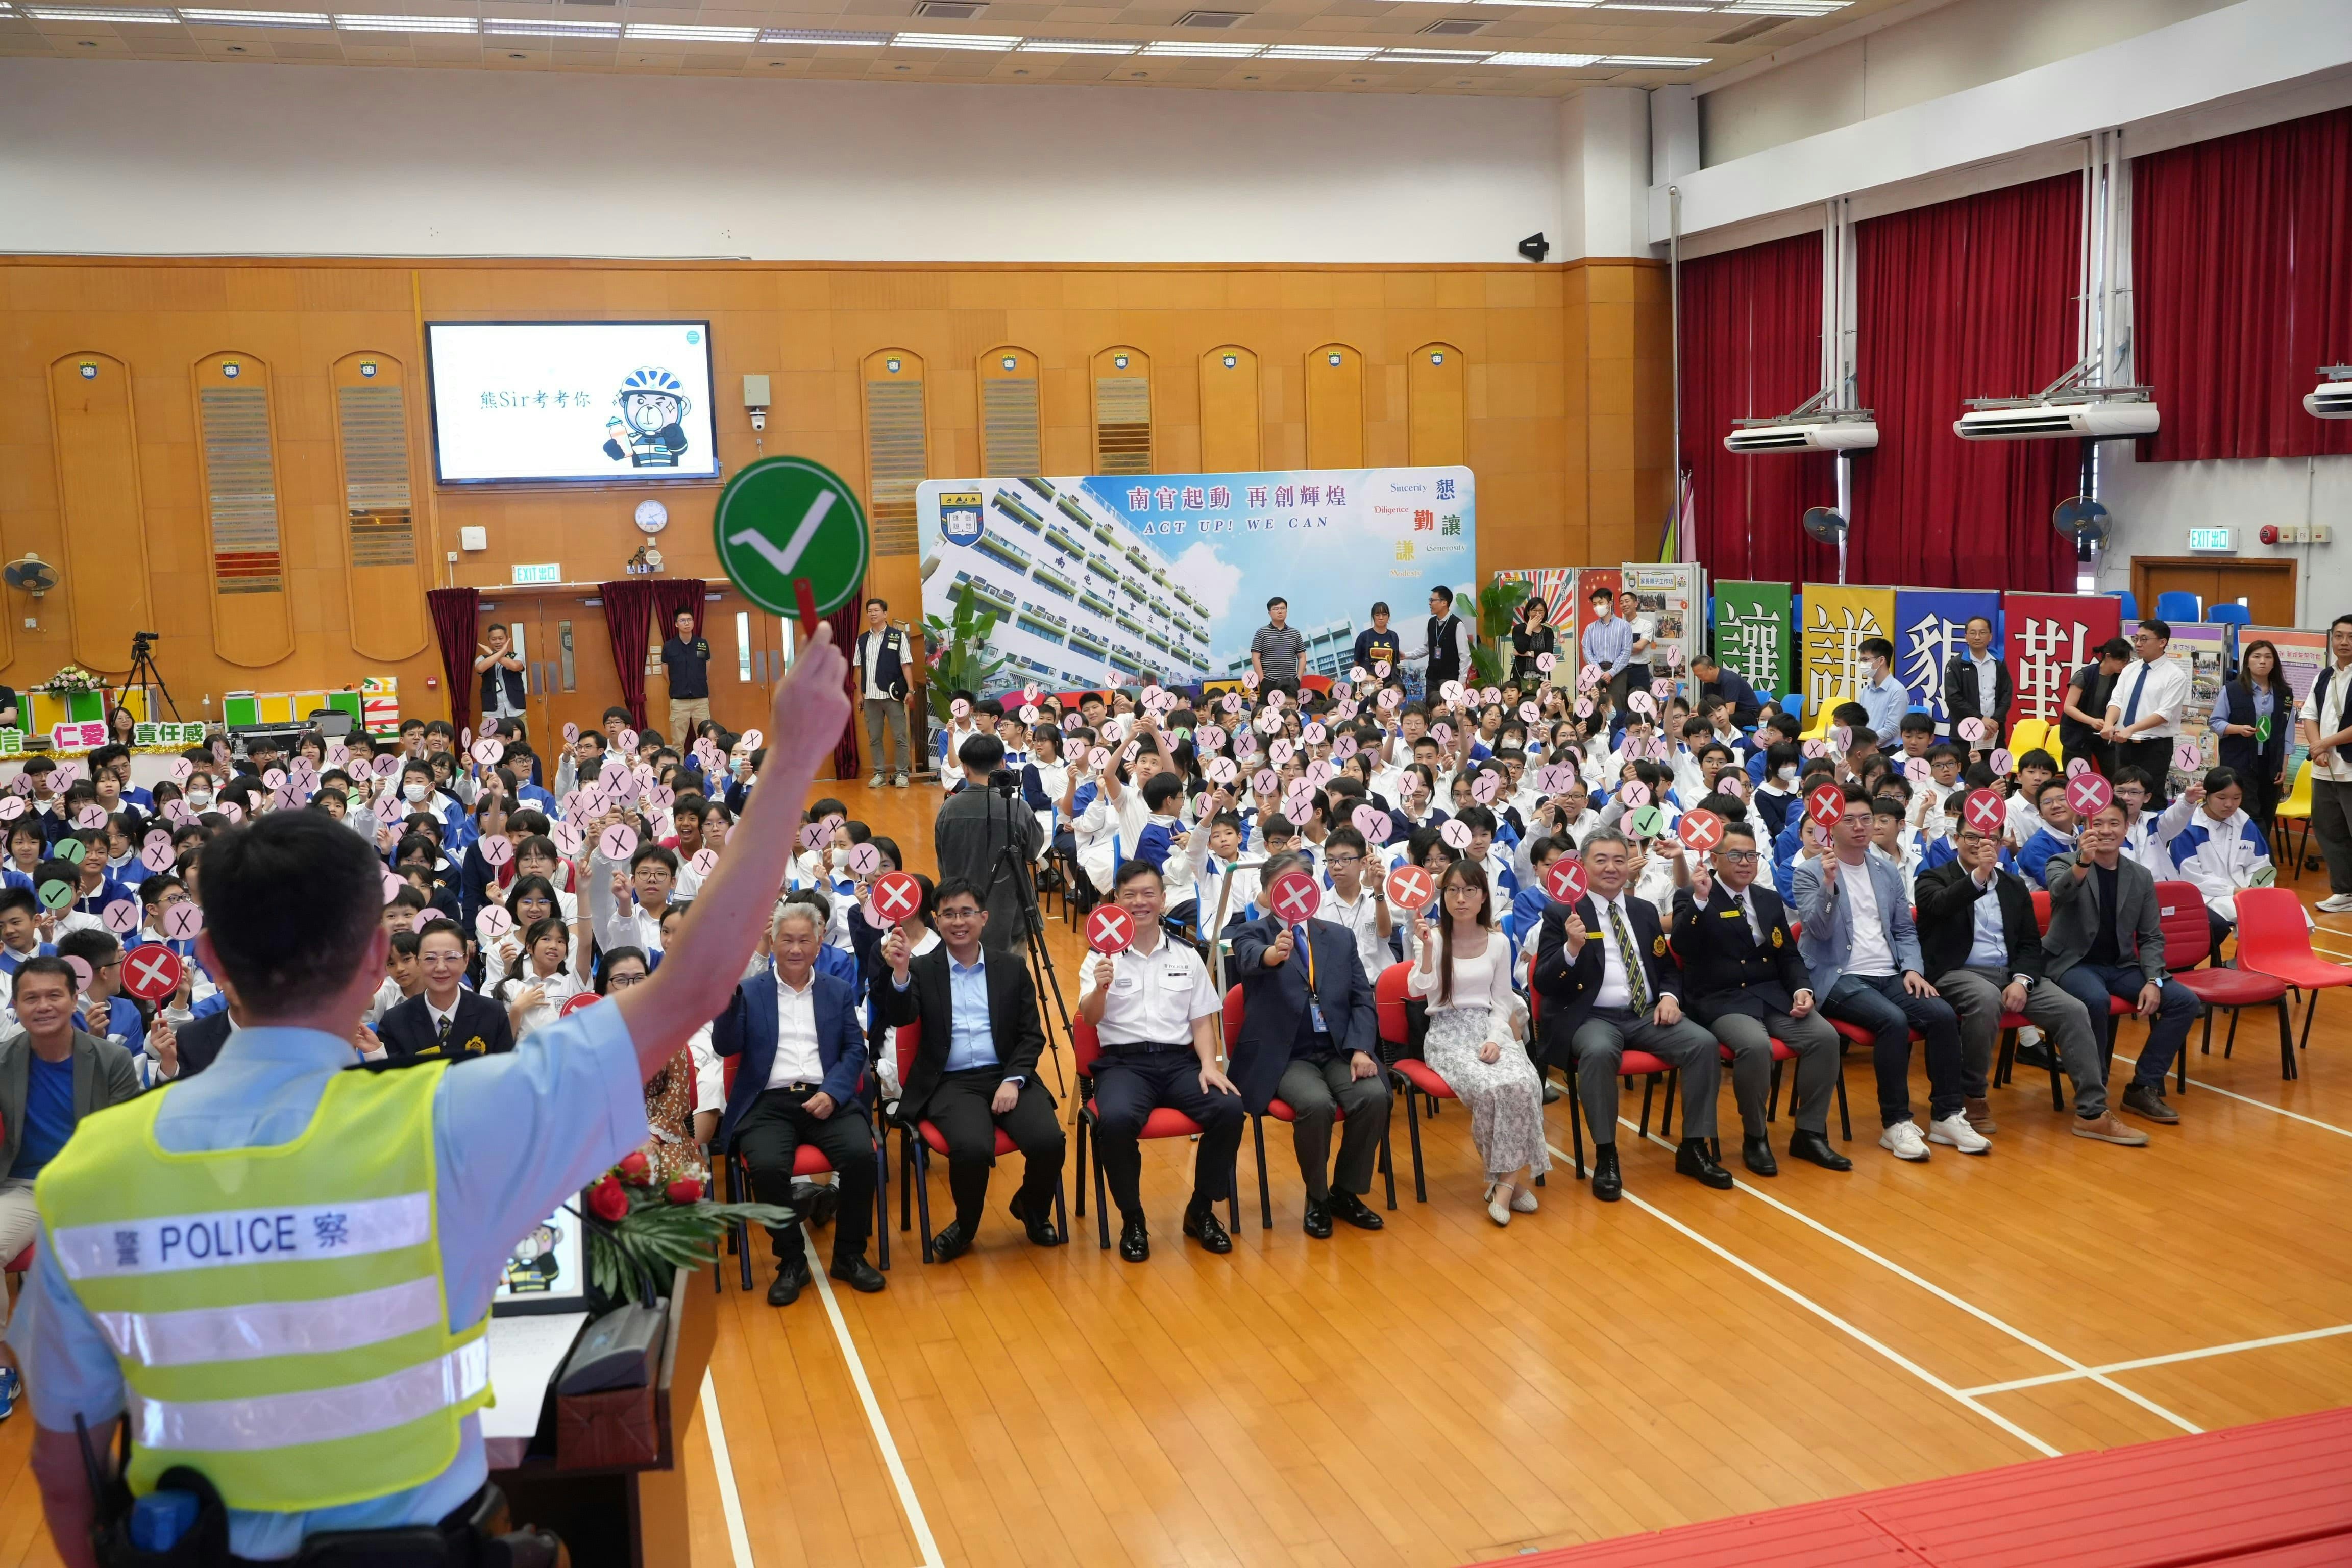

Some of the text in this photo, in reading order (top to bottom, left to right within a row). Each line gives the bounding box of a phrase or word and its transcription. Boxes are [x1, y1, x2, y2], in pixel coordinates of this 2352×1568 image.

[480, 391, 591, 410] 熊Sir考考你
[1128, 485, 1347, 510] 南官起動 再創輝煌
[1390, 483, 1428, 493] Sincerity
[1374, 506, 1409, 515] Diligence
[1145, 517, 1328, 534] ACT UP! WE CAN
[1413, 510, 1433, 531] 勤
[1441, 514, 1461, 536] 讓
[1426, 543, 1465, 552] Generosity
[2192, 530, 2227, 548] EXIT 出口
[1395, 540, 1415, 561] 謙
[517, 566, 555, 581] EXIT 出口
[1390, 569, 1422, 577] Modesty
[54, 723, 106, 749] 仁愛
[136, 723, 206, 744] 責任感
[114, 1212, 349, 1267] 警 POLICE 察
